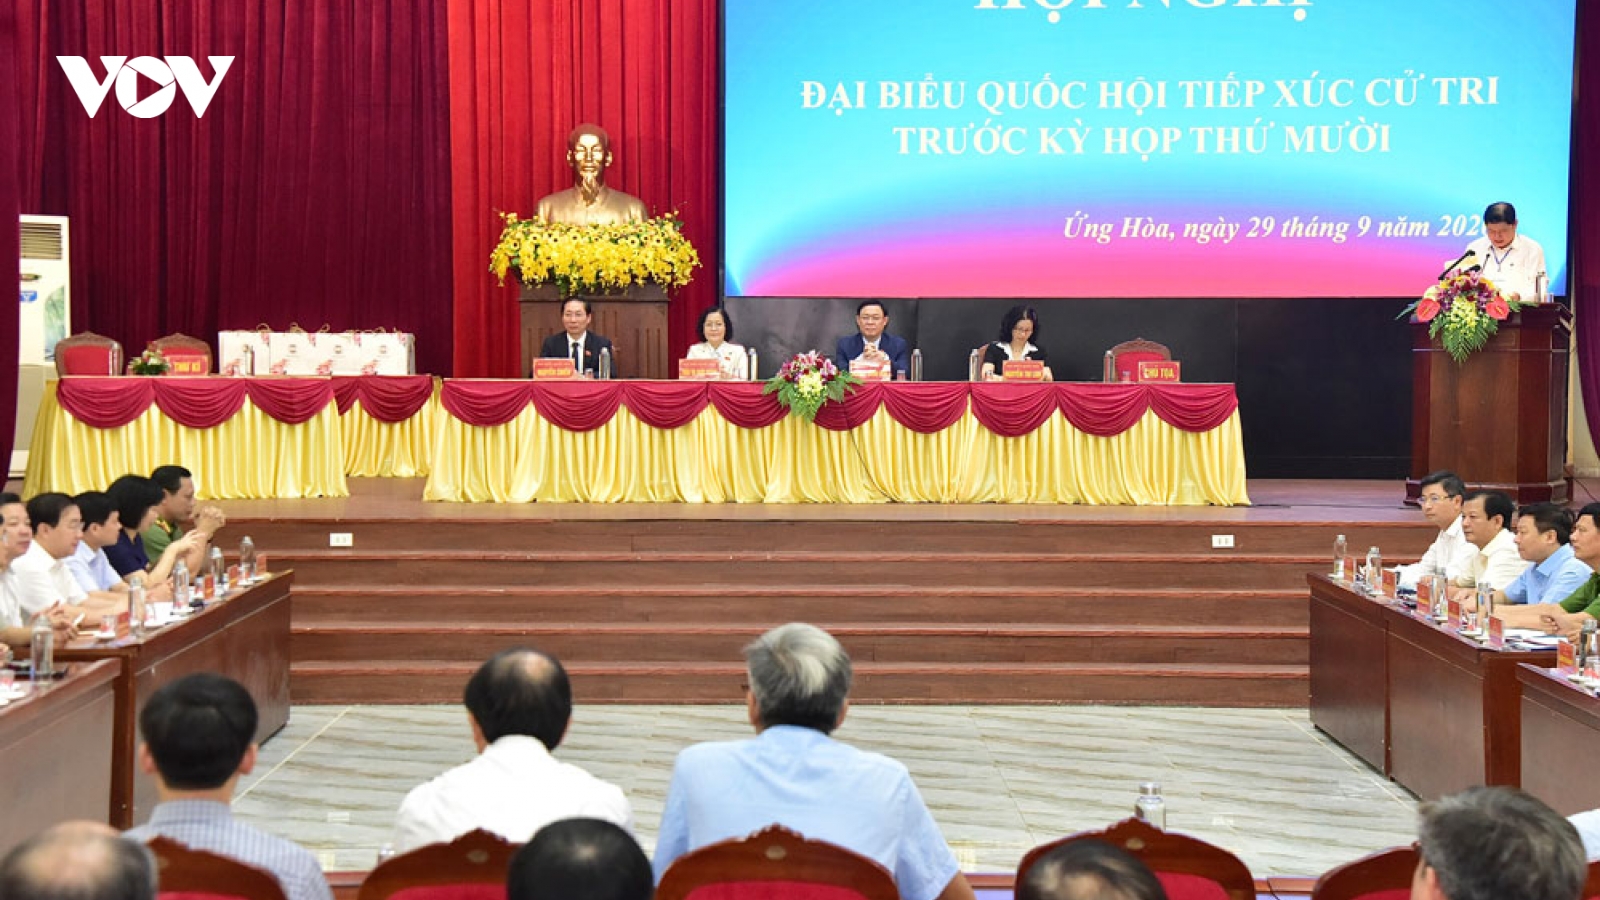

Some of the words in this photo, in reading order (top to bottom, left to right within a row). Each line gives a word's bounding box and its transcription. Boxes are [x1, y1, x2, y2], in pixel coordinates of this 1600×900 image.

[801, 82, 865, 115] ĐẠI
[879, 74, 964, 108] BIỂU
[977, 73, 1086, 115] QUỐC
[1099, 77, 1166, 116] HỘI
[1179, 72, 1264, 107] TIẾP
[1274, 71, 1354, 107] XÚC
[1365, 70, 1424, 106] CỬ
[1433, 77, 1497, 104] TRI
[893, 118, 1027, 155] TRƯỚC
[1038, 118, 1091, 154] KỲ
[1103, 127, 1182, 162] HỌP
[1190, 118, 1275, 154] THỨ
[1284, 116, 1389, 153] MƯỜI
[1065, 211, 1113, 243] Ứng
[1121, 217, 1174, 240] Hòa,
[1184, 216, 1240, 243] ngày
[1246, 216, 1275, 237] 29
[1281, 216, 1350, 242] tháng
[1358, 216, 1371, 237] 9
[1377, 217, 1429, 237] năm
